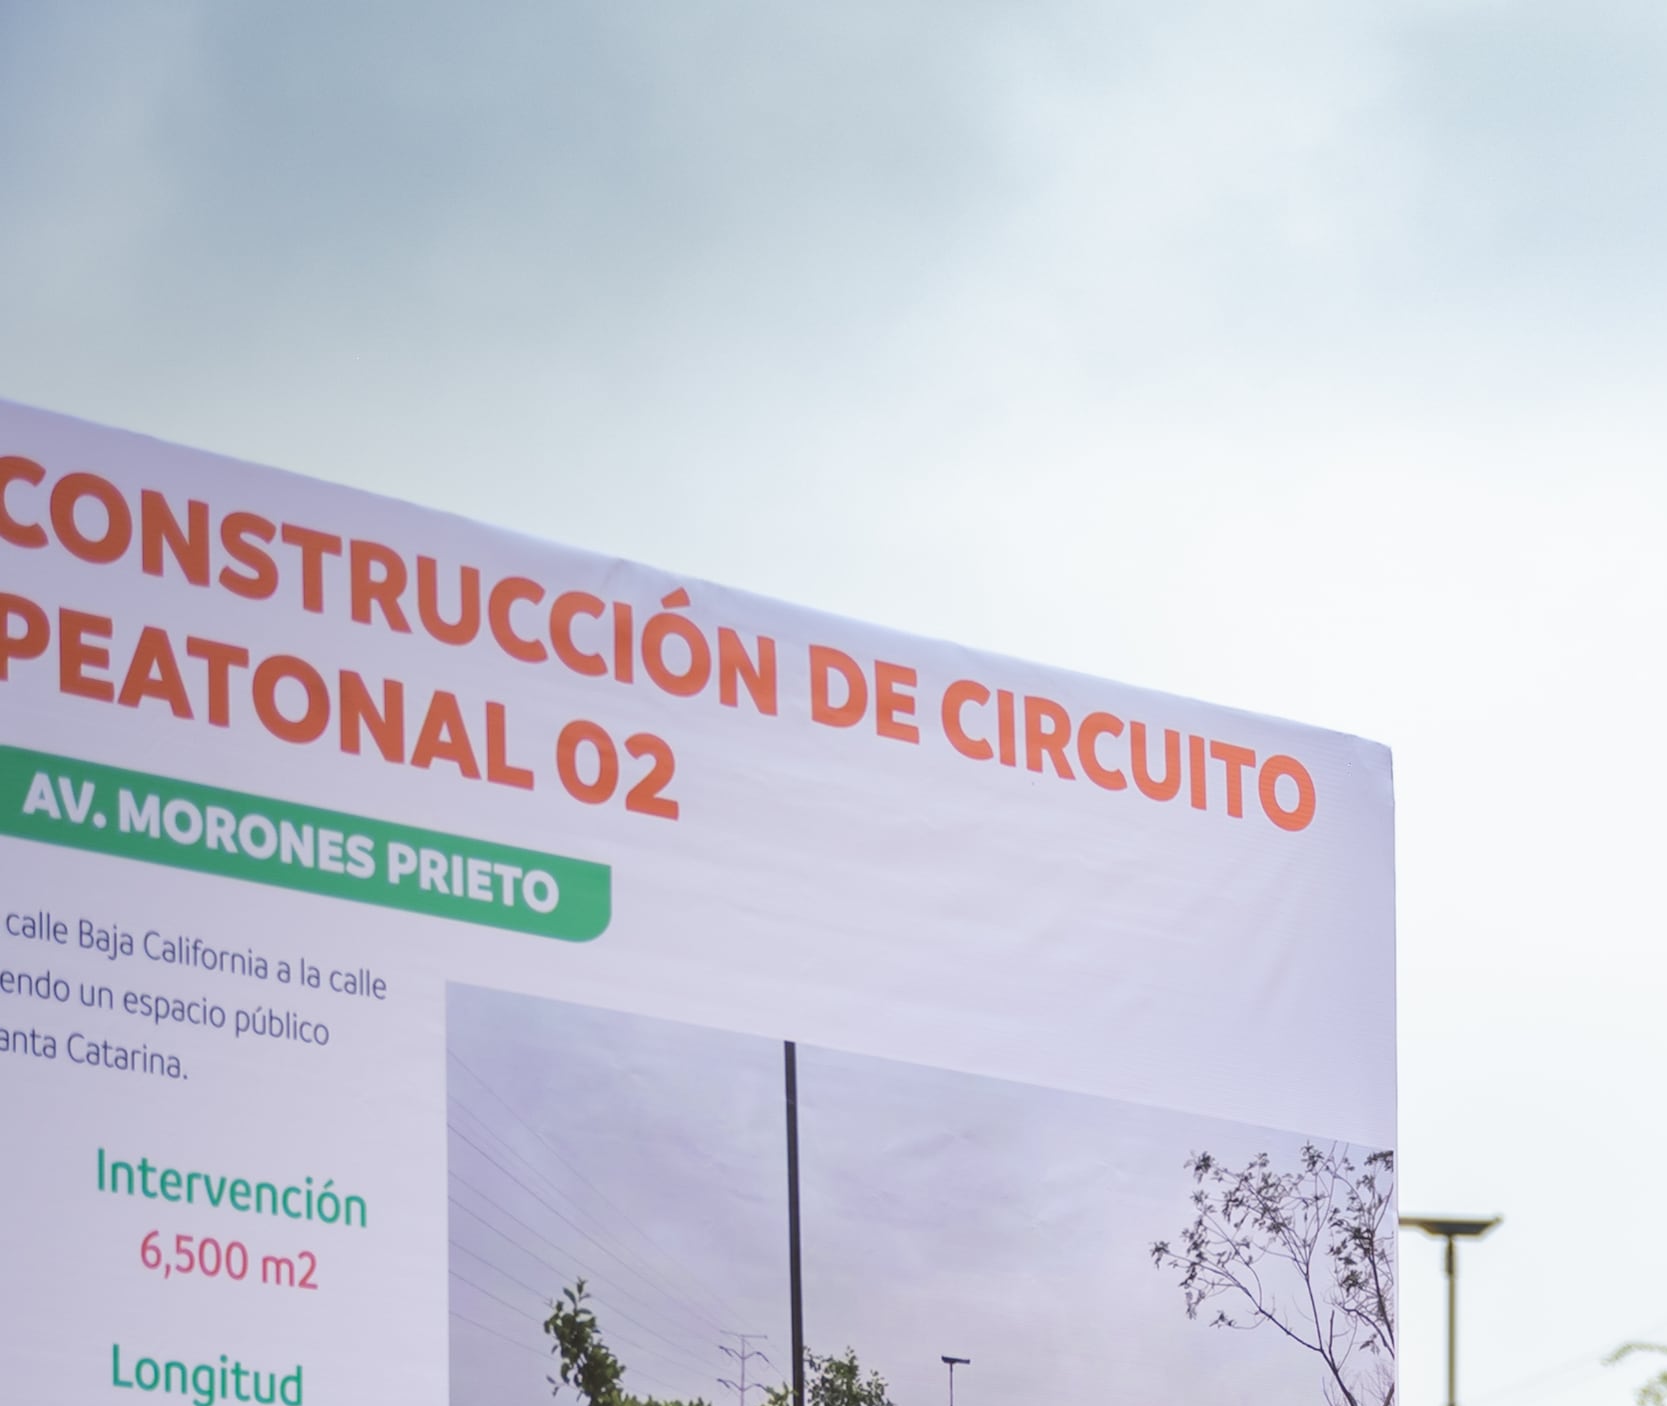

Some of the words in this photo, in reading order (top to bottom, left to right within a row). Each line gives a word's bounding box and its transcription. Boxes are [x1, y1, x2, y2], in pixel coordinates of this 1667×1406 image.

[0, 456, 778, 716] CONSTRUCCIÓN
[809, 644, 919, 744] DE
[941, 680, 1317, 832] CIRCUITO
[0, 593, 534, 790] PEATONAL
[556, 719, 679, 821] 02
[22, 772, 106, 829] AV.
[118, 790, 375, 879] MORONES
[387, 842, 560, 914] PRIETO
[6, 911, 68, 945] calle
[79, 919, 134, 961] Baja
[143, 930, 268, 980] California
[276, 959, 291, 984] a
[300, 957, 321, 989] la
[329, 967, 387, 1000] calle
[0, 969, 70, 1002] endo
[80, 982, 114, 1010] un
[123, 988, 227, 1028] espacio
[235, 1005, 330, 1047] público
[67, 1032, 188, 1080] Catarina.
[97, 1147, 367, 1228] Intervención
[140, 1230, 248, 1280] 6,500
[261, 1251, 318, 1290] m2
